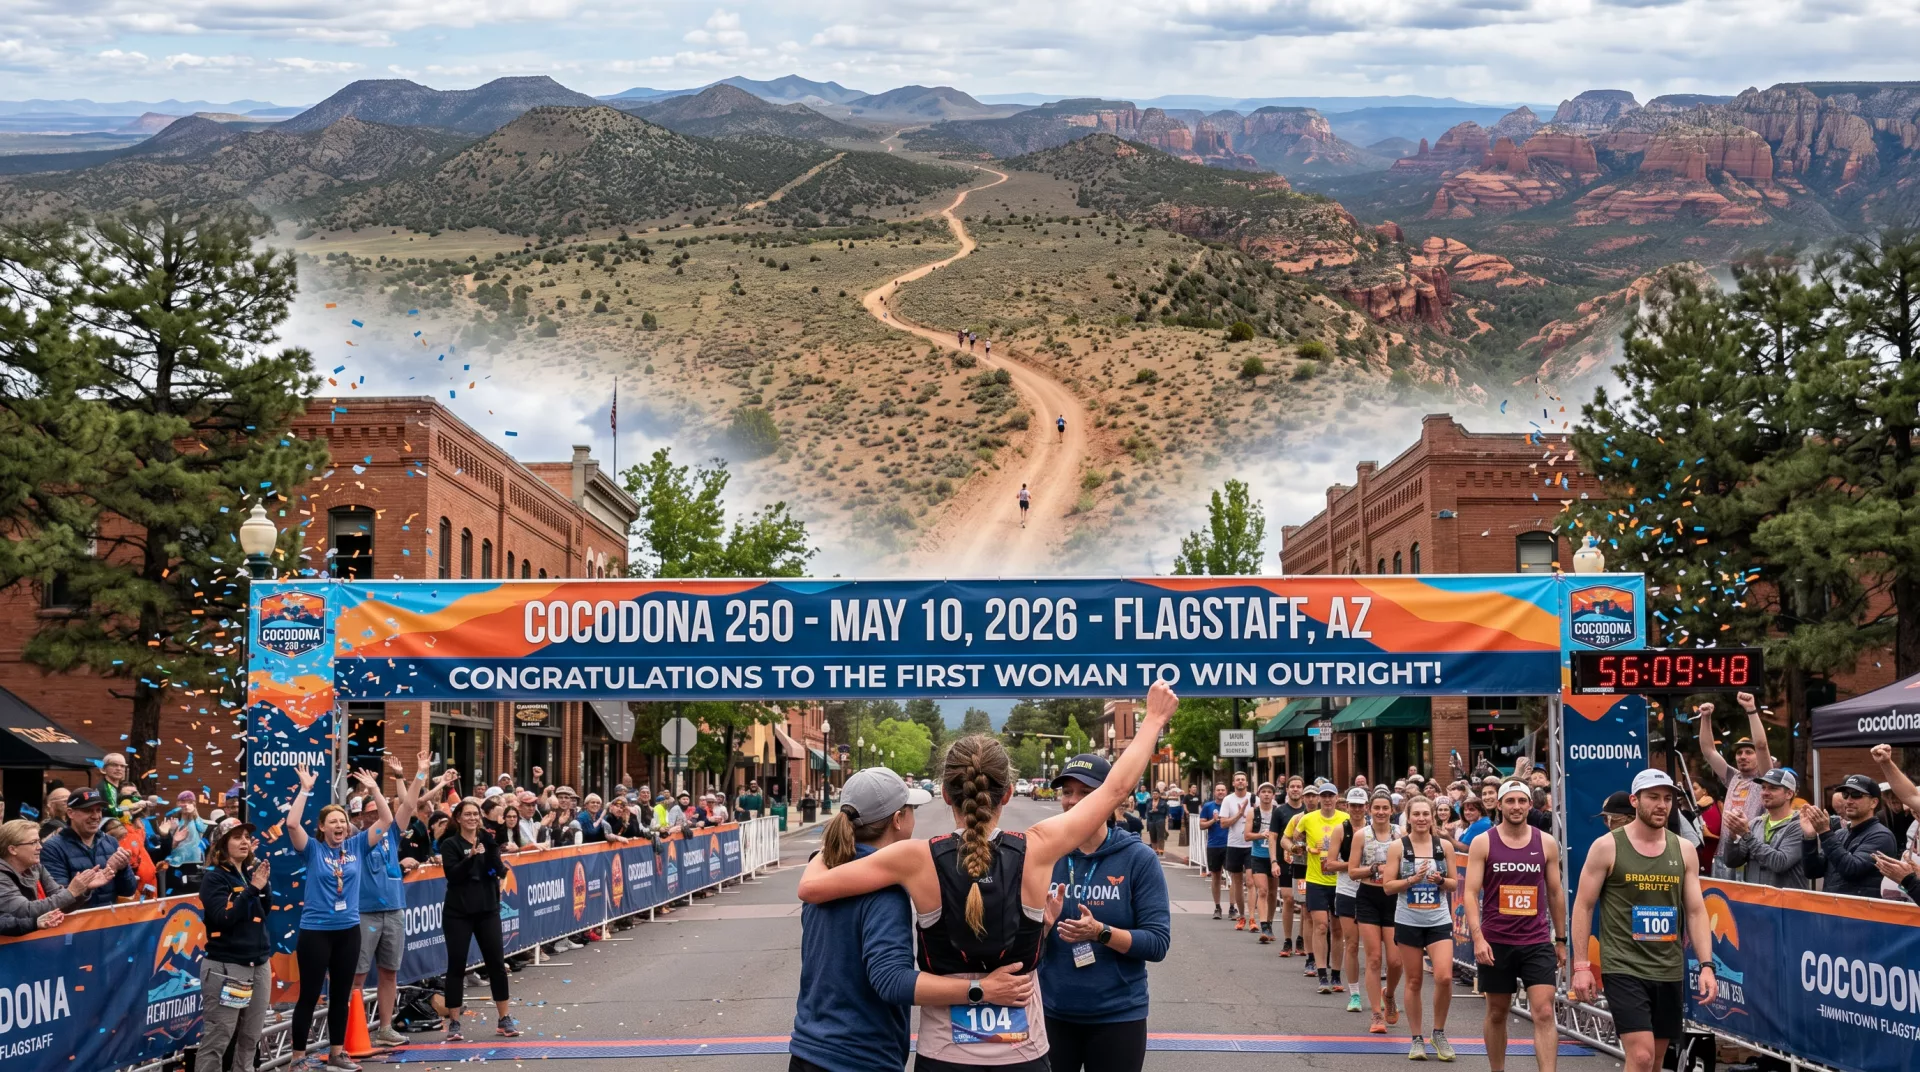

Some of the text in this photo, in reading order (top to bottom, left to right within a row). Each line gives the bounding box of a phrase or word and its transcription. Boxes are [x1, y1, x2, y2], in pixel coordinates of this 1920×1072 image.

[524, 600, 714, 643] COCODONA
[726, 599, 793, 642] 250
[830, 598, 906, 642] MAY
[921, 598, 973, 647] 10,
[985, 597, 1077, 641] 2026
[1114, 596, 1315, 645] FLAGSTAFF,
[1326, 596, 1372, 639] AZ
[1574, 622, 1632, 635] COCODONA
[262, 628, 321, 641] COCODONA
[449, 661, 1442, 690] CONGRATULATIONS TO THE FIRST WOMAN TO WIN OUTRIGHT!
[1599, 655, 1749, 687] 56:09:48
[1857, 709, 1920, 733] cocodona
[253, 751, 326, 767] COCODONA
[1569, 744, 1642, 760] COCODONA
[1492, 862, 1541, 873] SEDONA
[1642, 917, 1670, 934] 100
[0, 976, 71, 1034] DONA
[966, 1007, 1012, 1032] 104
